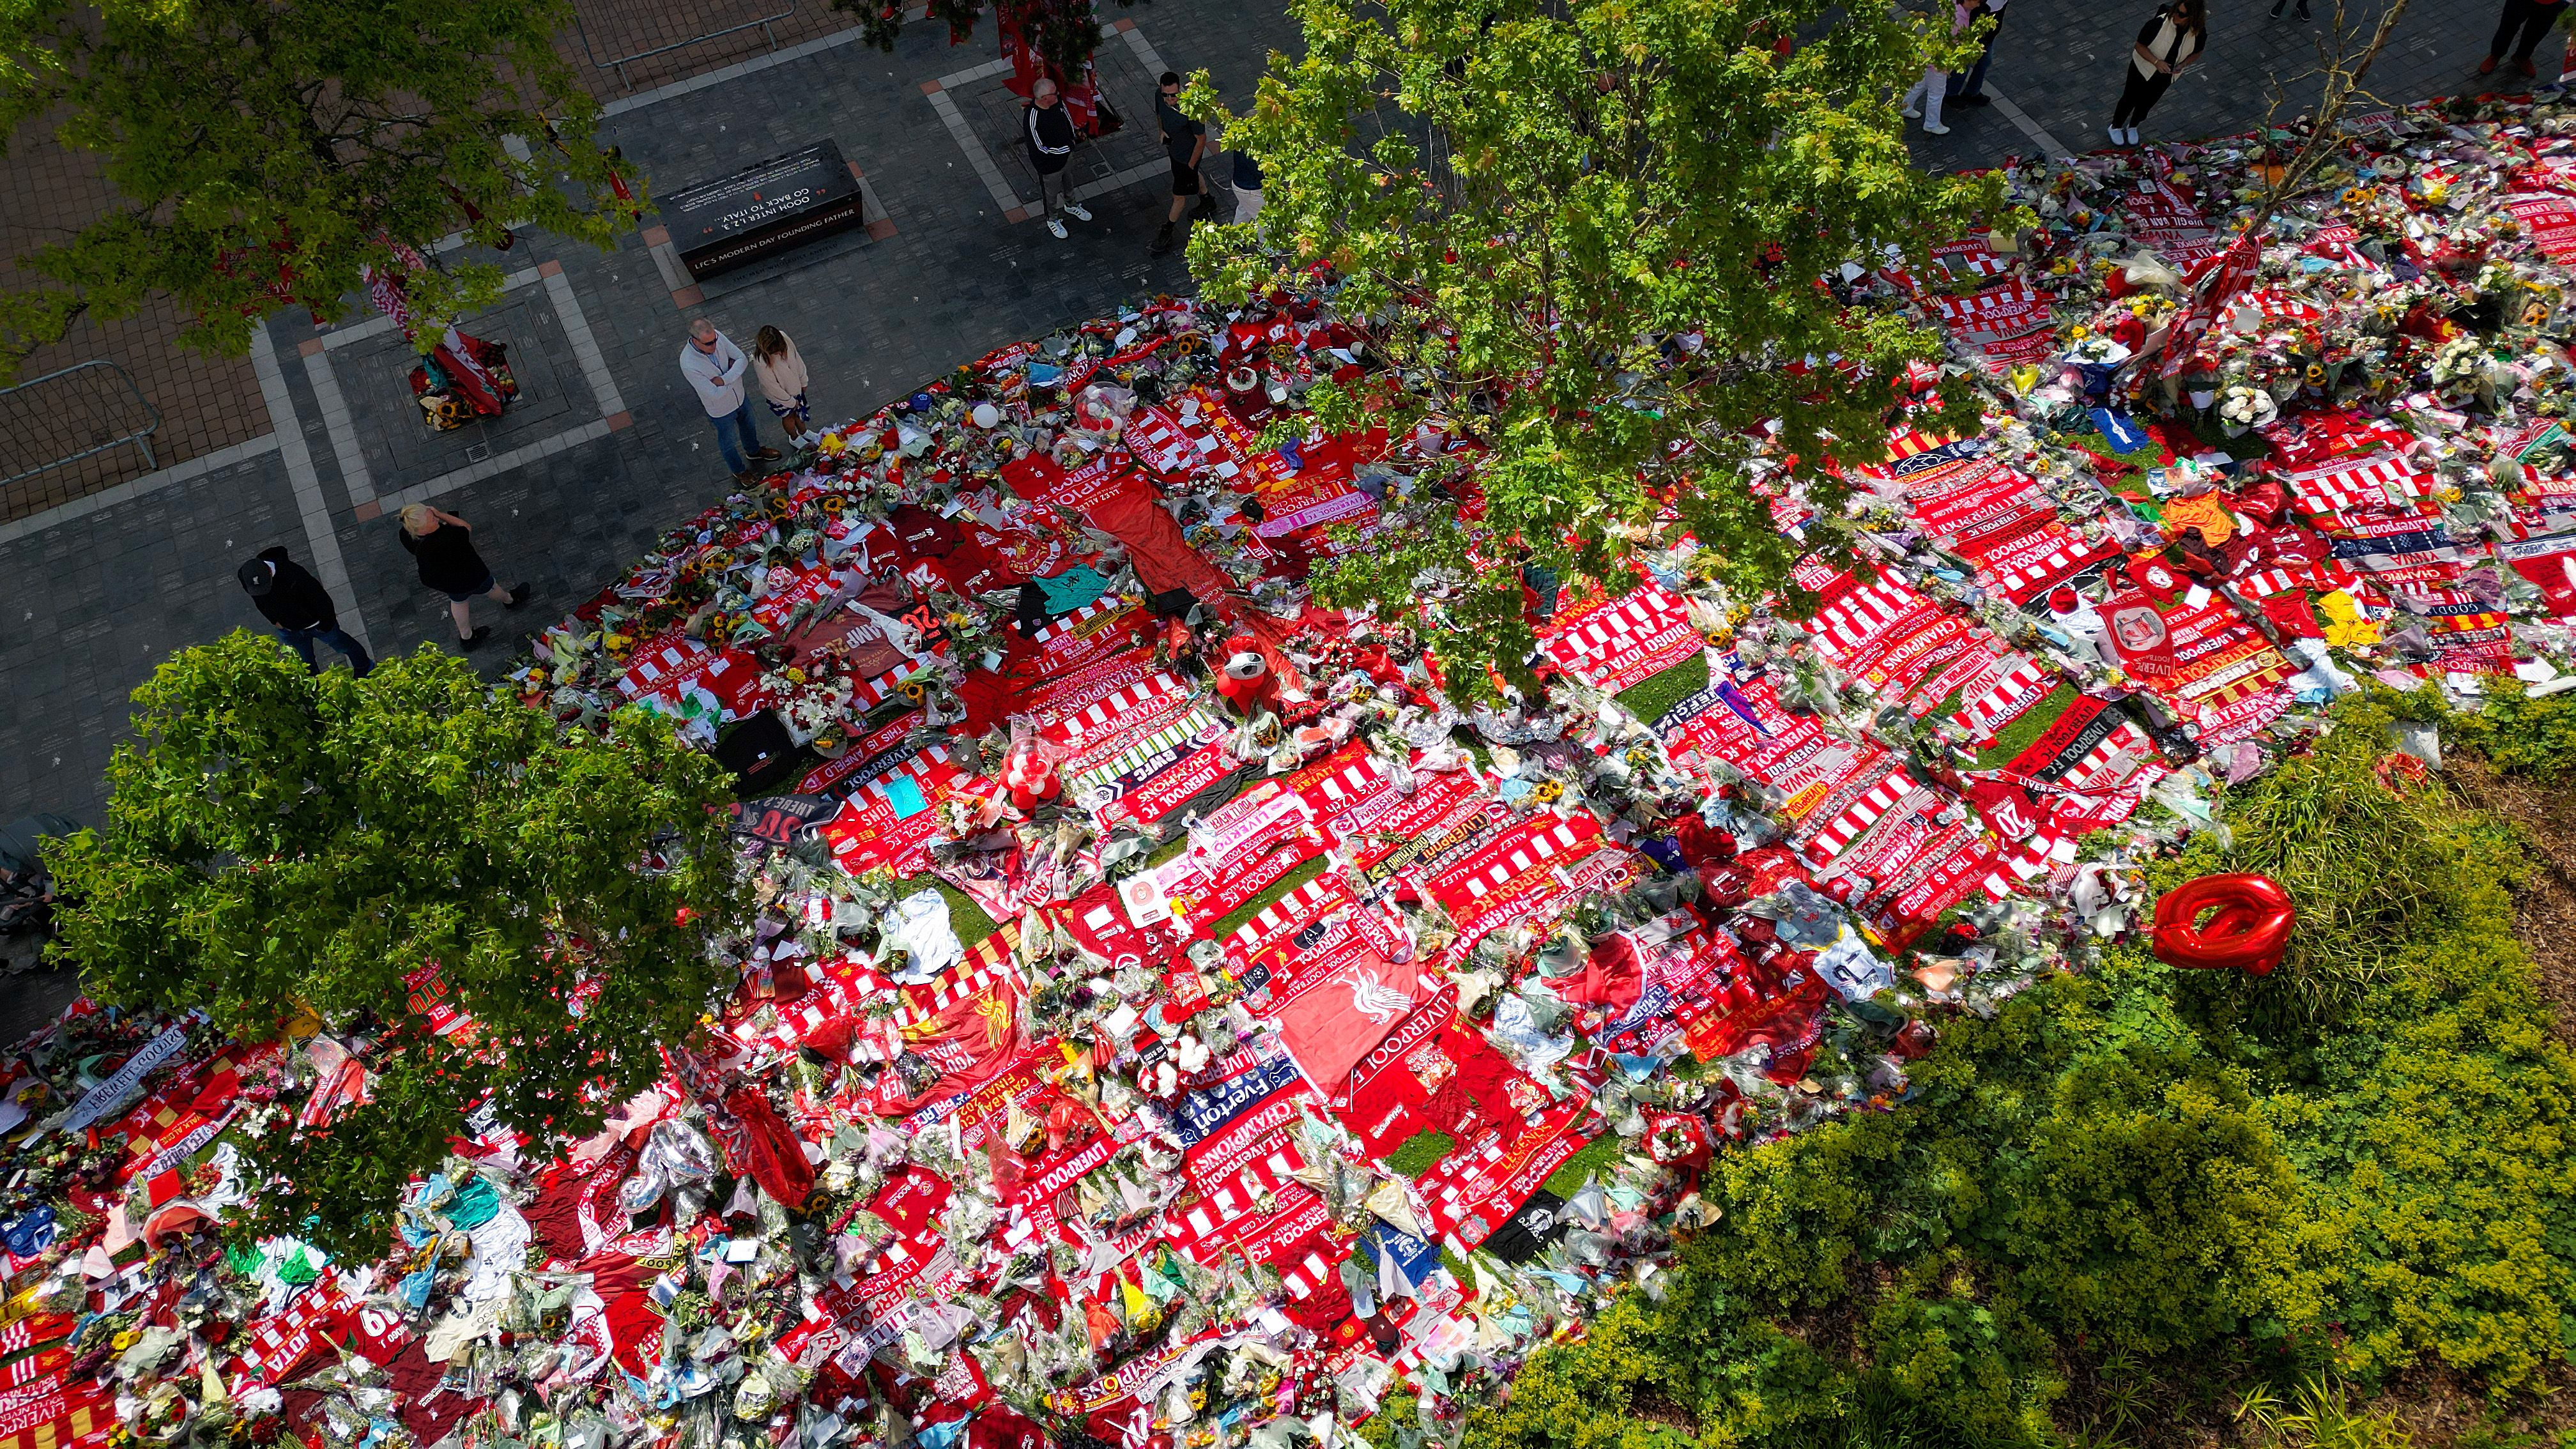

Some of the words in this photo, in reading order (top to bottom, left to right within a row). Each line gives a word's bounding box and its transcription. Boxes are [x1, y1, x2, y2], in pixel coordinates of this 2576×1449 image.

[770, 193, 792, 206] BACK
[794, 188, 810, 197] GO
[749, 204, 783, 221] INTER
[751, 203, 765, 213] TO
[785, 197, 810, 213] OOOH
[695, 259, 717, 270] LFC'S
[719, 243, 758, 263] MODERN
[758, 238, 776, 250] DAY
[778, 222, 822, 241] FOUNDING
[825, 208, 855, 226] FATHER
[1932, 241, 1981, 257] LIVERPOOL
[1958, 313, 1971, 325] FC
[1979, 300, 2031, 322] LIVERPOOL
[1209, 419, 1246, 464] LIVERPOOL
[2315, 454, 2348, 471] POLSKA
[2322, 459, 2365, 477] LIVERPOOL
[2309, 471, 2320, 479] FC
[1270, 489, 1333, 521] LIVERPOOL
[1967, 526, 1981, 538] FC
[1981, 509, 2020, 533] LIVERPOOL
[2366, 519, 2430, 539] Liverpool
[1984, 528, 2048, 565] LIVERPOOL
[2012, 537, 2067, 572] LIVERPOOL
[1805, 566, 1834, 590] ALLEZ
[1997, 564, 2014, 579] FC
[1851, 600, 1920, 651] LIVERPOOL
[1644, 621, 1691, 654] DIOGO
[1882, 617, 1958, 672] CHAMPIONS
[2174, 630, 2234, 665] LIVERPOOL
[1609, 645, 1646, 673] JOTA
[1644, 657, 1665, 673] WALK
[2185, 641, 2254, 682] LIVERPOOL
[1621, 668, 1646, 686] ALONE
[1908, 666, 1925, 682] FC
[2181, 658, 2257, 703] LIVERPOOL
[737, 683, 758, 699] crown
[1059, 666, 1144, 717] CHAMPIONS
[1085, 691, 1170, 744] CHAMPIONS
[1688, 719, 1706, 735] FC
[2052, 704, 2097, 746] LIVERPOOL
[867, 739, 880, 752] IS
[880, 724, 905, 745] THIS
[1749, 719, 1820, 772] LIVERPOOL
[2060, 719, 2110, 763] LIVERPOOL
[1763, 734, 1825, 781] LIVERPOOL
[2040, 742, 2057, 759] FC
[824, 748, 865, 778] ANFIELD
[843, 743, 916, 792] LIVERPOOL
[1134, 747, 1177, 783] BWFC
[1137, 751, 1213, 802] CHAMPIONS
[1157, 764, 1218, 808] LIVERPOOL
[1777, 760, 1827, 797] YNWA
[1141, 801, 1160, 819] FC
[1326, 792, 1358, 818] 12th
[1356, 790, 1401, 825] ARSENAL
[1382, 782, 1452, 834] LIVERPOOL
[1210, 811, 1234, 831] NEVER
[1856, 800, 1912, 855] LIVERPOOL
[1993, 800, 2030, 836] 20
[883, 827, 903, 842] ALONE
[886, 834, 904, 850] FC
[1499, 831, 1529, 853] ALLEZ
[1257, 855, 1278, 872] NEVER
[1386, 834, 1431, 870] DORTMUND
[1839, 850, 1862, 872] FC
[1880, 841, 1915, 874] SALAH
[1947, 852, 1973, 877] THIS
[1239, 869, 1257, 884] WALK
[1439, 866, 1472, 889] ALLEZ
[1492, 850, 1573, 903] LIVERPOOL
[1935, 871, 1949, 885] IS
[1218, 881, 1239, 898] ALONE
[1222, 891, 1240, 908] FC
[1897, 880, 1935, 914] ANFIELD
[1309, 889, 1342, 915] WALK
[1473, 894, 1496, 915] FC
[1920, 886, 1959, 921] REDS
[1294, 908, 1312, 924] ON
[1453, 900, 1528, 955] LIVERPOOL
[1802, 910, 1821, 925] AXA
[1262, 919, 1294, 945] WALK
[1245, 939, 1264, 956] ON
[1296, 922, 1353, 968] LIVERPOOL
[1278, 968, 1294, 985] FC
[1287, 968, 1327, 999] FOOTBALL
[1705, 970, 1721, 986] FA
[1684, 979, 1707, 999] CUP
[786, 986, 822, 1017] WALK
[1653, 993, 1687, 1023] FINAL
[1681, 1008, 1695, 1021] IS
[1689, 1000, 1733, 1038] THE
[1359, 995, 1453, 1073] LIVERPOOL
[981, 1072, 1016, 1100] FINAL
[912, 1096, 956, 1130] PALACE
[1193, 1076, 1271, 1133] Everton
[1372, 1103, 1406, 1138] CHAMPIONS
[1195, 1100, 1292, 1170] CHAMPIONS
[1031, 1158, 1047, 1174] FC
[1038, 1141, 1107, 1192] LIVERPOOL
[1525, 1151, 1546, 1171] NEVER
[1510, 1171, 1528, 1189] WALK
[1489, 1188, 1510, 1208] ALONE
[1494, 1199, 1515, 1218] FC
[1295, 1204, 1321, 1225] NEVER
[1239, 1219, 1258, 1236] CLUB
[1272, 1220, 1296, 1239] WALK
[1246, 1235, 1273, 1255] ALONE
[1250, 1244, 1273, 1264] FC
[839, 1255, 920, 1315] LIVERPOOL
[475, 1301, 506, 1327] DIOGO
[840, 1271, 928, 1338] LIVERPOOL
[822, 1309, 843, 1328] FC
[864, 1310, 910, 1350] LILLE
[266, 1326, 313, 1372] JOTA
[818, 1328, 843, 1351] FC
[27, 1375, 57, 1392] YOU'LL
[33, 1393, 64, 1411] YOU'LL
[0, 1406, 33, 1423] NEVER
